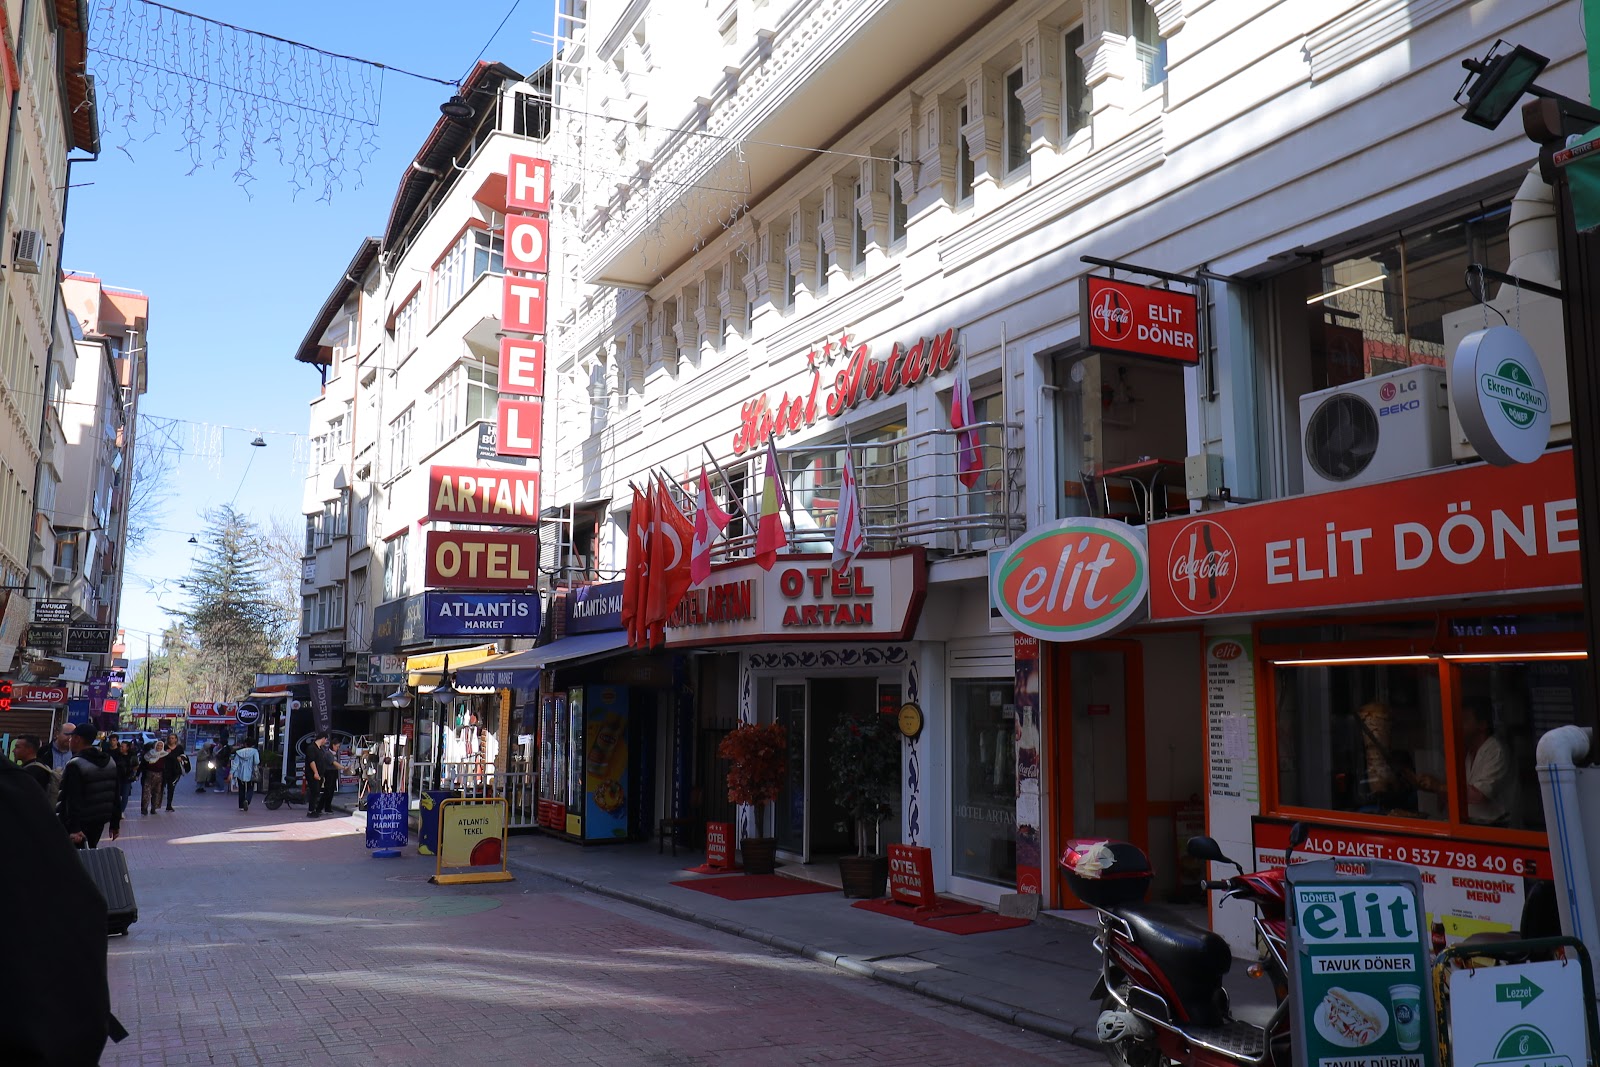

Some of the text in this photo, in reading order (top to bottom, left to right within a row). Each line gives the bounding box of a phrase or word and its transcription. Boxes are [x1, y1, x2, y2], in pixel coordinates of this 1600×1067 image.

[506, 163, 546, 449] HOTEL
[1148, 304, 1182, 324] ELİT
[1137, 323, 1194, 349] DÖNER
[732, 327, 957, 455] Hotel Artan
[1400, 380, 1417, 393] LG
[1487, 378, 1543, 407] Ekrem Coşkun
[1380, 399, 1420, 417] BEKO
[1508, 407, 1529, 422] DÖNER
[434, 475, 535, 516] ARTAN
[1265, 498, 1580, 585] ELİT DÖNE
[435, 541, 530, 580] OTEL
[780, 566, 875, 598] OTEL
[1016, 536, 1116, 616] elit
[439, 599, 529, 617] ATLANTİS
[573, 593, 607, 619] ATLANTİS
[667, 579, 756, 629] OTEL ARTAN
[782, 603, 874, 627] ARTAN
[464, 620, 505, 629] MARKET
[70, 630, 109, 639] AVUKAT
[1015, 636, 1037, 646] DÖNER
[1216, 642, 1236, 658] elit
[497, 671, 514, 685] MARKET
[371, 812, 402, 820] ATLANTİS
[458, 816, 489, 826] ATLANTİS
[955, 805, 1017, 824] HOTEL ARTAN
[373, 821, 400, 829] MARKET
[708, 832, 726, 844] OTEL
[708, 843, 726, 853] ARTAN
[1304, 837, 1333, 852] ALO
[1337, 840, 1384, 858] PAKET
[1412, 847, 1438, 865] 537
[1445, 850, 1477, 869] 798
[1483, 854, 1507, 871] 40
[890, 859, 920, 876] OTEL
[892, 874, 922, 887] ARTAN
[1451, 876, 1516, 894] EKONOMİK
[1301, 892, 1336, 903] DÖNER
[1466, 889, 1502, 904] MENÜ
[1302, 891, 1414, 940] elit
[1318, 956, 1412, 972] TAVUK DÖNER
[1505, 986, 1532, 999] Lezzet
